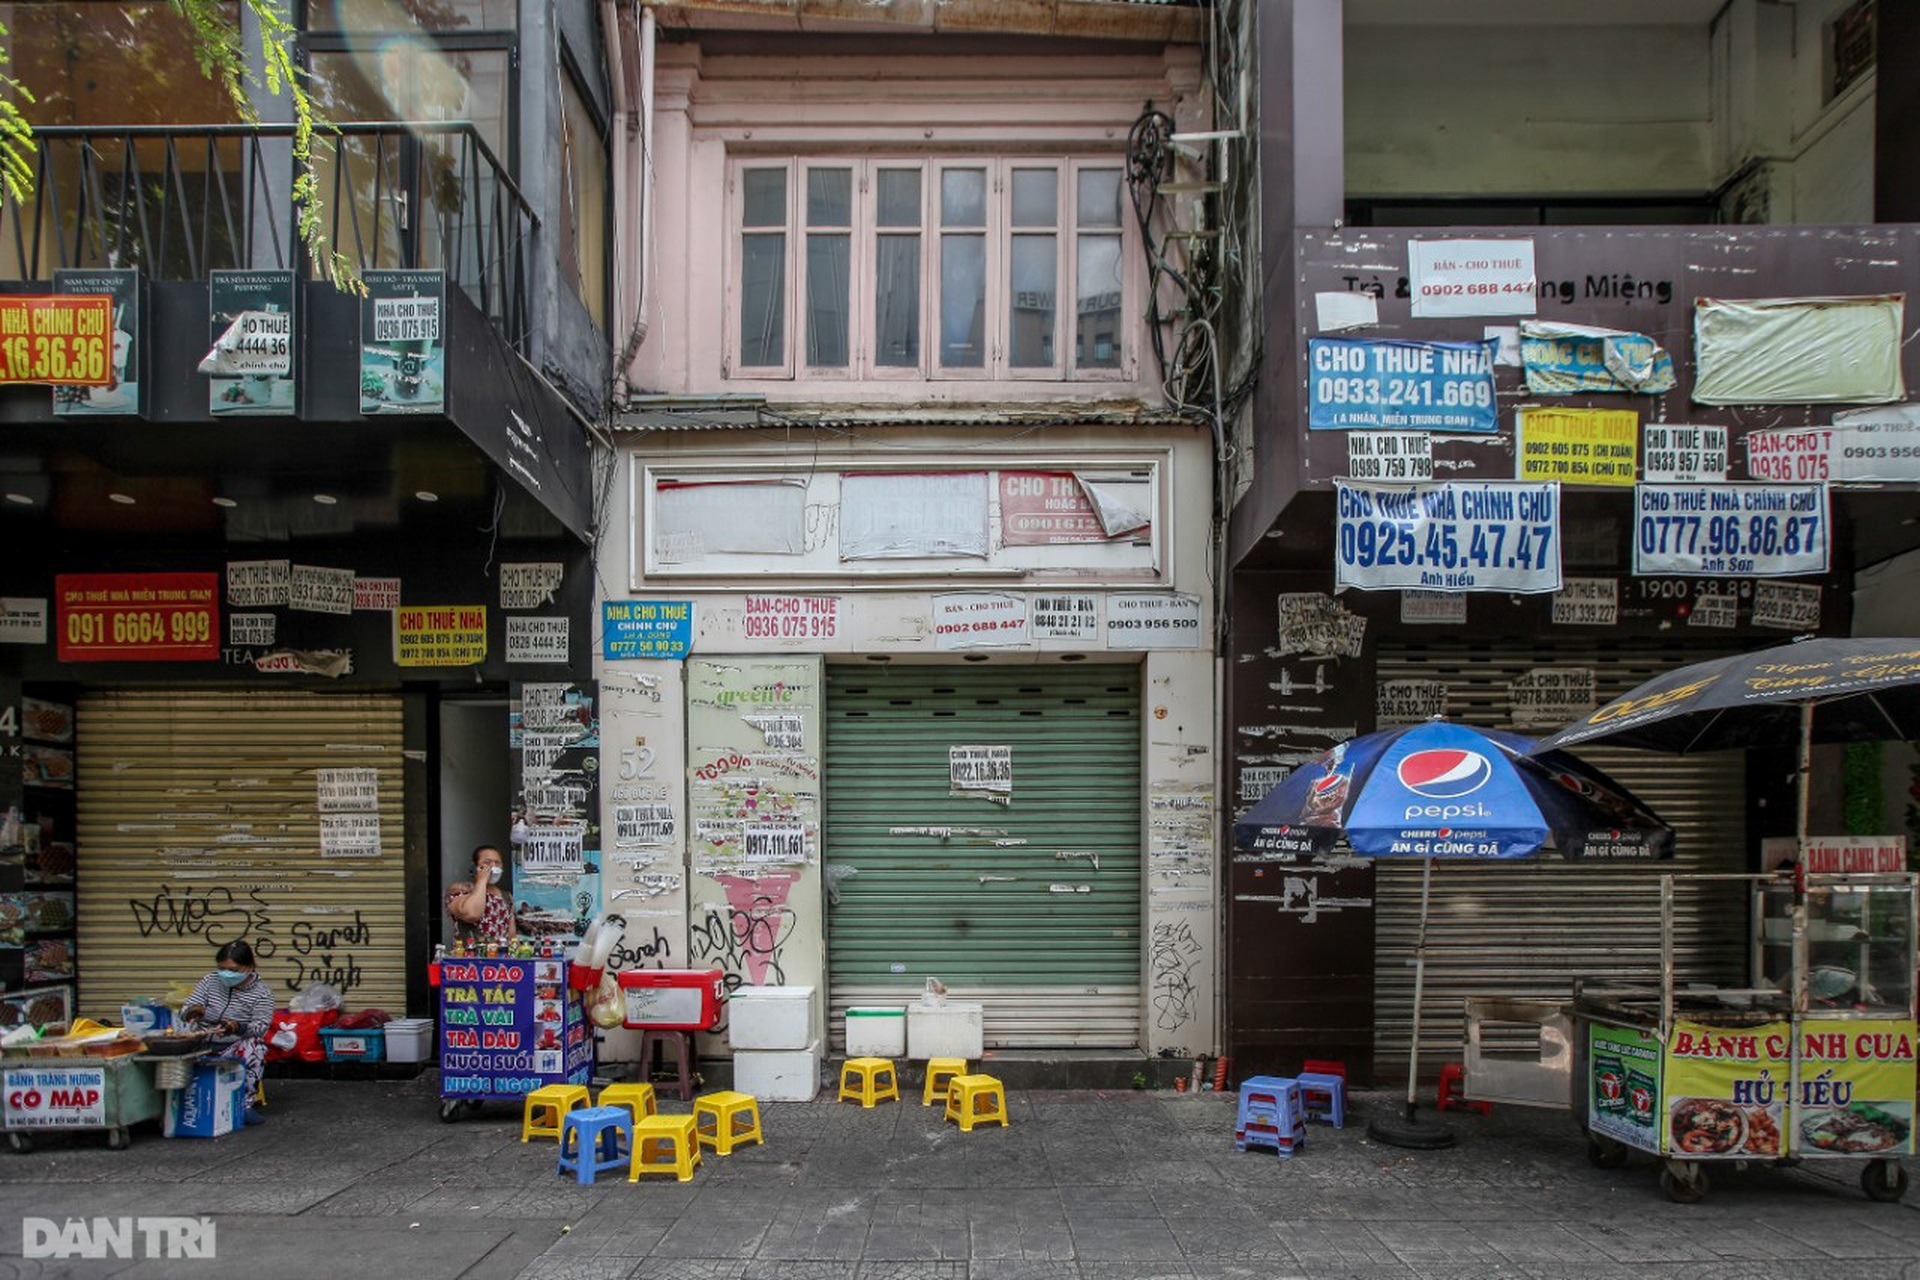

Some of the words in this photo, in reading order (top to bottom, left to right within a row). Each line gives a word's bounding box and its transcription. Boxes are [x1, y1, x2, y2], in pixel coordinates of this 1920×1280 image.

[1466, 261, 1489, 270] CHO
[1491, 258, 1523, 268] THUÊ
[1422, 285, 1464, 296] 0902
[1468, 284, 1498, 294] 688
[1502, 283, 1534, 294] 447
[1584, 274, 1673, 306] Miệng
[377, 302, 396, 318] NHÀ
[397, 304, 415, 317] CHO
[416, 300, 437, 316] THUÊ
[1, 302, 30, 335] NHÀ
[32, 302, 74, 335] CHÍNH
[77, 302, 104, 336] CHỦ
[260, 314, 288, 334] THUÊ
[377, 320, 400, 339] 0936
[402, 320, 419, 338] 075
[420, 320, 437, 338] 915
[272, 338, 286, 355] 36
[1316, 346, 1367, 372] CHO
[1373, 346, 1435, 373] THUÊ
[1442, 343, 1496, 374] NHÀ
[1317, 378, 1491, 408] 0933.241.669
[1858, 422, 1882, 433] CHO
[1350, 434, 1373, 456] NHÀ
[1377, 437, 1398, 456] CHO
[1400, 433, 1430, 455] THUÊ
[1647, 430, 1666, 450] CHO
[1672, 426, 1700, 450] THUÊ
[1704, 426, 1726, 450] NHÀ
[1526, 443, 1550, 454] 0902
[1552, 443, 1569, 454] 605
[1572, 444, 1590, 456] 875
[1844, 448, 1890, 458] 0903
[1350, 458, 1381, 478] 0989
[1384, 458, 1406, 478] 759
[1410, 458, 1432, 478] 798
[1526, 460, 1550, 473] 0972
[1572, 462, 1589, 474] 854
[1648, 452, 1674, 472] 0933
[1678, 452, 1700, 472] 957
[1702, 452, 1724, 472] 550
[1797, 454, 1830, 480] 075
[1007, 477, 1044, 496] CHO
[1044, 498, 1076, 513] HOẶC
[1340, 487, 1374, 518] CHO
[1376, 486, 1420, 520] THUÊ
[1422, 484, 1457, 520] NHÀ
[1462, 485, 1514, 520] CHÍNH
[1519, 485, 1552, 522] CHỦ
[1642, 492, 1669, 510] CHO
[1674, 489, 1706, 510] THUÊ
[1712, 488, 1740, 510] NHÀ
[1745, 488, 1786, 510] CHÍNH
[1791, 486, 1818, 512] CHỦ
[1642, 516, 1820, 556] 0777.96.86.87
[1340, 522, 1552, 570] 0925.45.47.47
[229, 567, 246, 585] CHO
[248, 561, 270, 584] THUÊ
[272, 562, 289, 582] NHÀ
[1702, 558, 1724, 572] Anh
[1728, 557, 1754, 572] Sơn
[502, 570, 520, 587] CHO
[521, 564, 542, 587] THUÊ
[1421, 572, 1443, 586] Anh
[1446, 570, 1474, 586] Hiếu
[65, 592, 84, 602] CHO
[86, 590, 108, 602] THUÊ
[158, 590, 186, 600] TRUNG
[1640, 580, 1688, 598] 1900
[1758, 583, 1774, 599] CHO
[634, 605, 656, 620] CHO
[660, 602, 688, 620] THUÊ
[970, 602, 989, 612] CHO
[991, 600, 1014, 610] THUÊ
[1035, 598, 1051, 612] CHO
[1119, 600, 1138, 609] CHO
[1140, 600, 1162, 608] THUÊ
[1554, 604, 1616, 622] 0931.339.227
[68, 612, 104, 644] 091
[114, 612, 166, 644] 6664
[172, 610, 210, 642] 999
[400, 612, 424, 630] CHO
[426, 608, 456, 630] THUÊ
[460, 608, 484, 630] NHÀ
[510, 619, 528, 633] NHÀ
[530, 622, 546, 633] CHO
[548, 619, 568, 633] THUÊ
[618, 621, 652, 630] CHÍNH
[656, 620, 678, 630] CHỦ
[746, 616, 778, 636] 0936
[783, 616, 807, 636] 075
[812, 616, 836, 636] 915
[936, 624, 970, 634] 0902
[972, 622, 998, 632] 688
[1000, 620, 1026, 630] 447
[1108, 620, 1144, 630] 0903
[1146, 620, 1172, 630] 956
[533, 636, 554, 649] 4444
[556, 636, 567, 648] 36
[610, 642, 636, 652] 0777
[671, 642, 684, 652] 33
[221, 649, 255, 664] TEA
[1537, 674, 1561, 688] CHO
[1564, 673, 1593, 687] THUÊ
[1390, 686, 1412, 698] CHO
[1415, 684, 1444, 698] THUÊ
[0, 706, 20, 737] 4
[952, 750, 967, 759] CHO
[619, 748, 656, 781] 52
[696, 754, 752, 781] 100%
[527, 790, 544, 806] CHO
[617, 808, 632, 822] CHO
[1404, 802, 1483, 820] pepsi
[618, 822, 674, 838] 0911.7777.69
[1400, 830, 1438, 839] CHEERS
[1454, 830, 1488, 842] pepsi
[524, 842, 580, 862] 0917.111.661
[1276, 838, 1299, 850] CŨNG
[1390, 840, 1410, 852] ĂN
[1434, 840, 1475, 854] CŨNG
[1478, 841, 1500, 855] ĐÃ
[1809, 842, 1840, 873] BÁNH
[1844, 847, 1874, 872] CANH
[1879, 847, 1902, 872] CUA
[444, 962, 480, 982] TRÀ
[482, 963, 524, 982] ĐÀO
[444, 986, 480, 1004] TRÀ
[445, 1006, 480, 1025] TRÀ
[446, 1028, 480, 1048] TRÀ
[482, 1029, 520, 1049] DÂU
[1672, 1030, 1760, 1061] BÁNH
[1856, 1034, 1915, 1060] CUA
[444, 1052, 492, 1070] NƯỚC
[494, 1050, 535, 1070] SUỐI
[8, 1072, 35, 1086] BÁNH
[444, 1074, 492, 1092] NƯỚC
[1733, 1070, 1776, 1104] HỦ
[50, 1087, 100, 1114] MẬP
